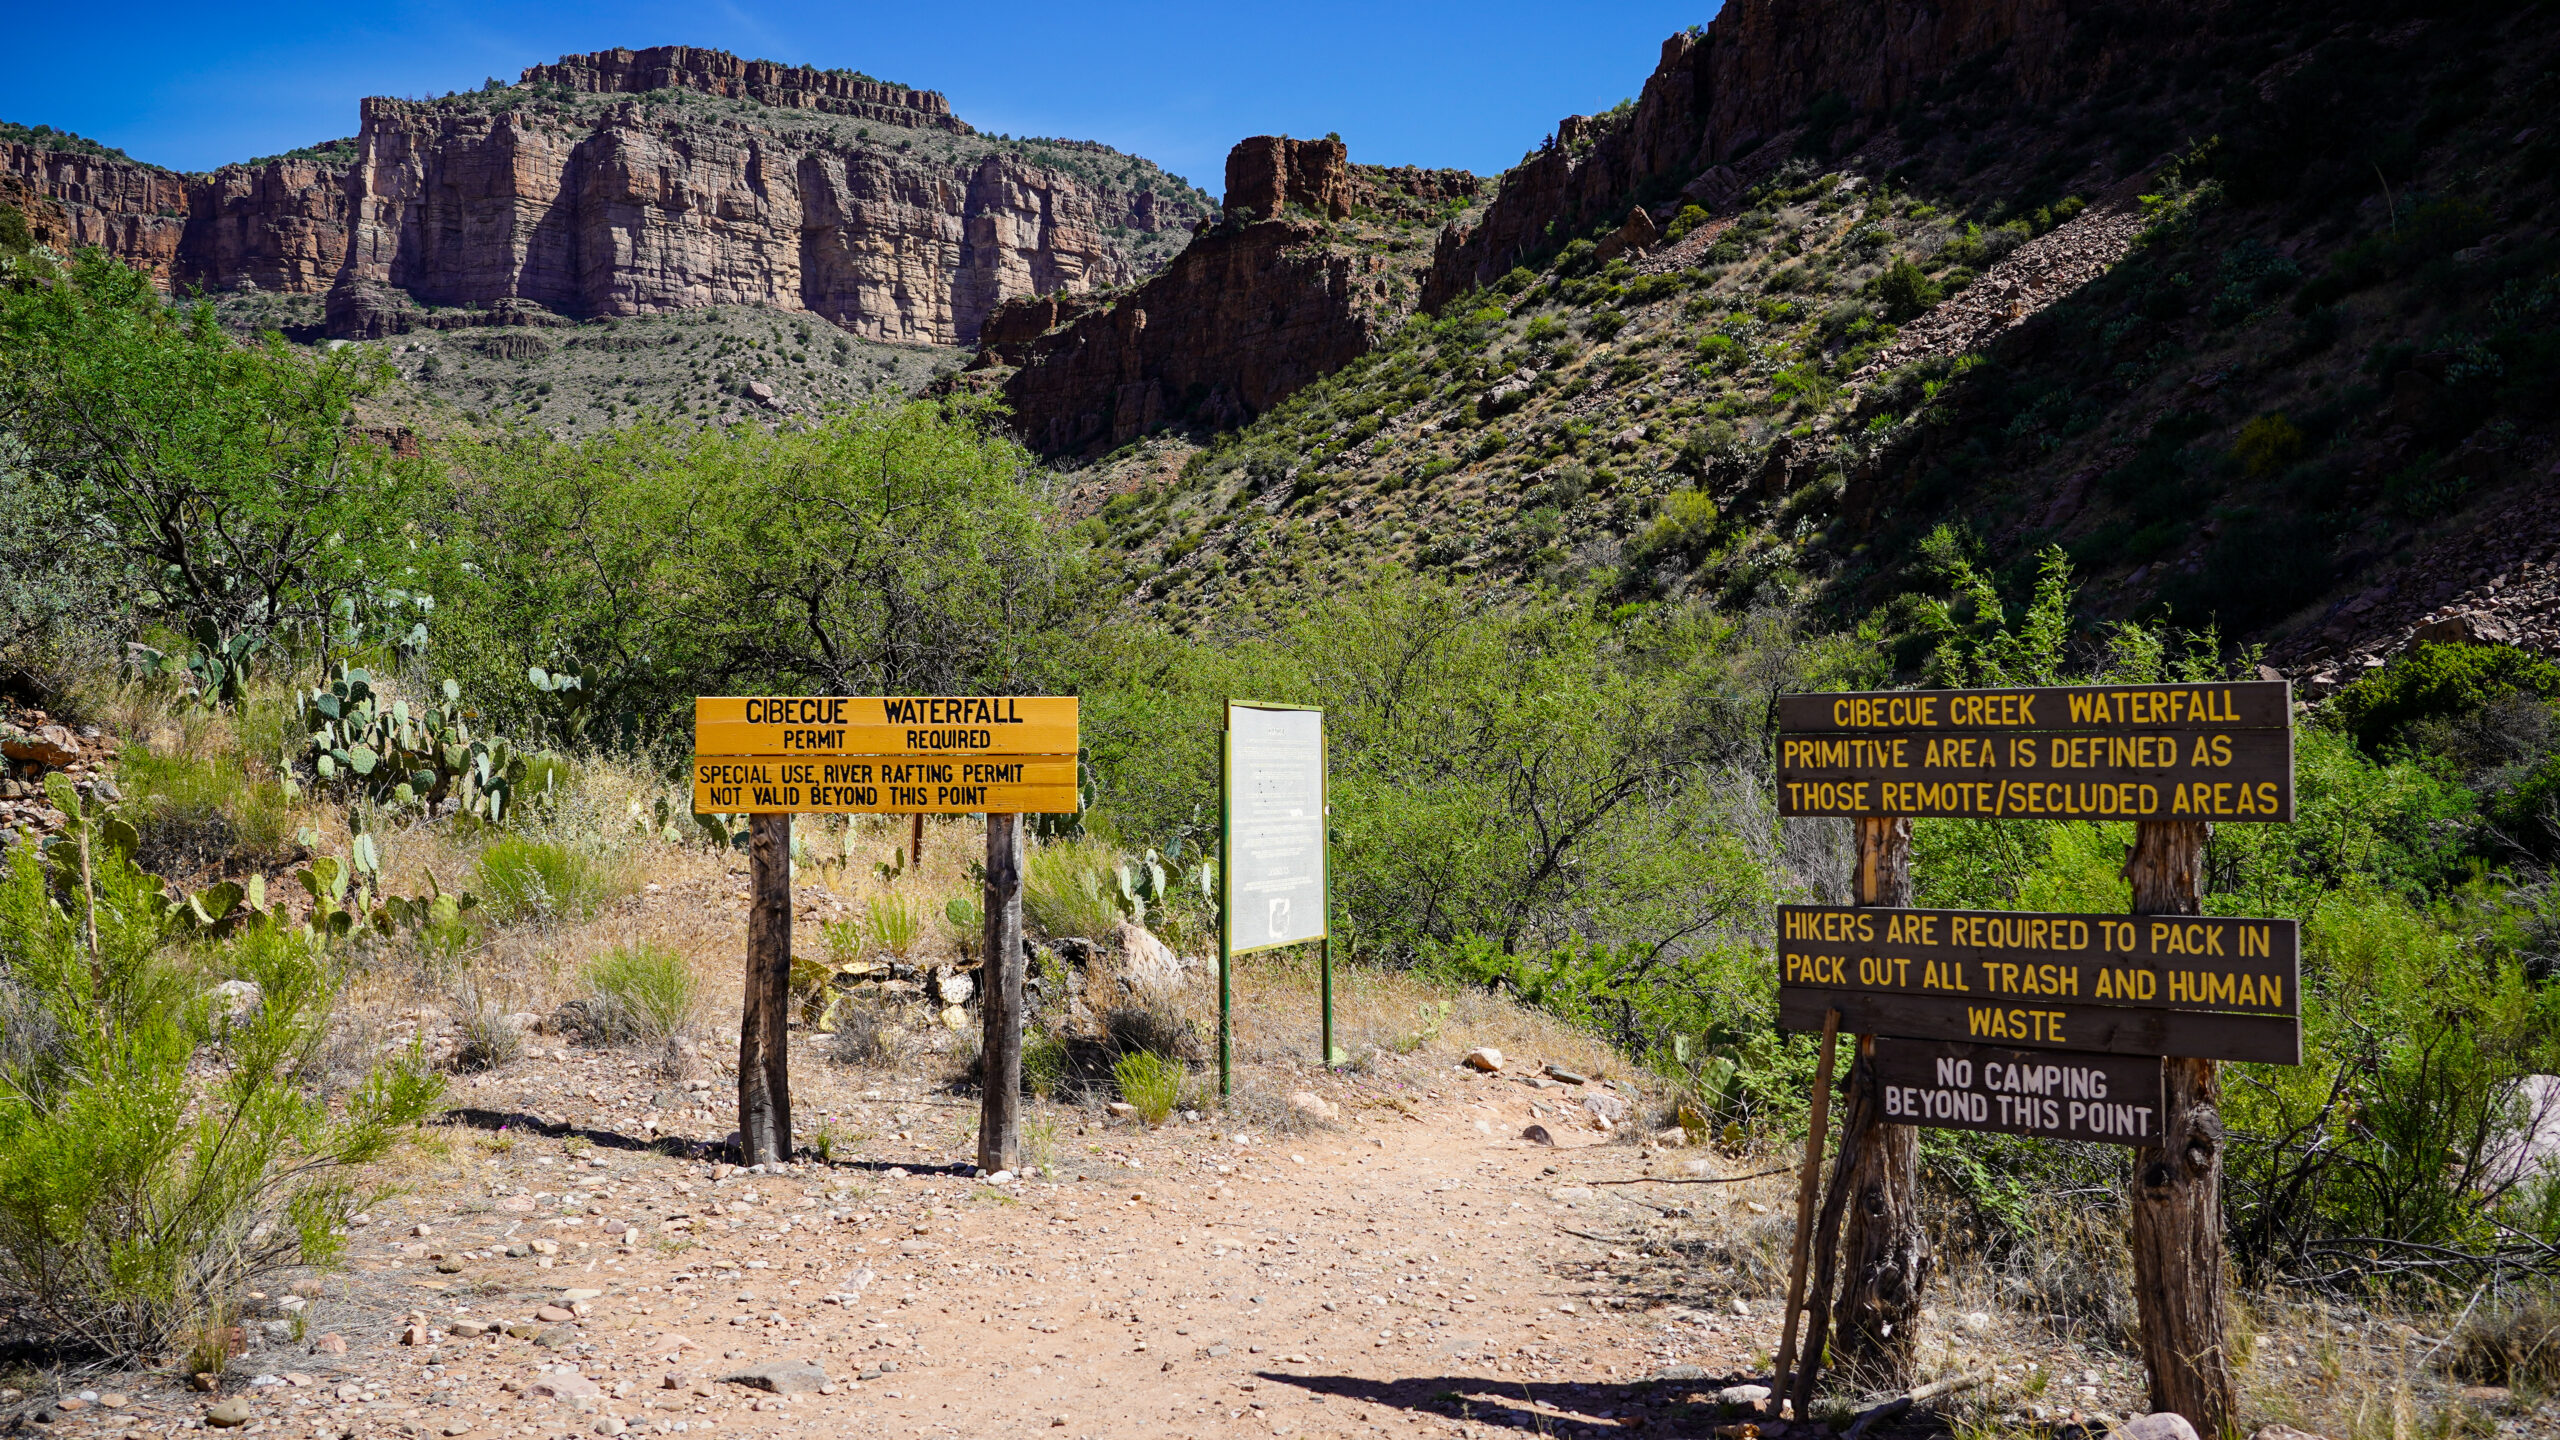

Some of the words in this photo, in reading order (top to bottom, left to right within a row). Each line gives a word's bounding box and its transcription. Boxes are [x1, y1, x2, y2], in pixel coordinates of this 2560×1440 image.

[746, 699, 848, 724] CIBECUE
[884, 699, 1023, 724] WATERFALL
[1834, 697, 1937, 726] CIBECUE
[1951, 695, 2035, 725] CREEK
[2069, 690, 2240, 723] WATERFALL
[784, 730, 845, 749] PERMIT
[907, 730, 990, 749] REQUIRED
[1785, 739, 1908, 768] PRIMITIVE
[1925, 739, 1995, 767] AREA
[2011, 739, 2036, 767] IS
[2052, 737, 2176, 767] DEFINED
[2192, 735, 2231, 766] AS
[700, 766, 771, 784] SPECIAL
[782, 765, 820, 787] USE,
[825, 765, 872, 783] RIVER
[882, 765, 952, 783] RAFTING
[964, 764, 1023, 782] PERMIT
[711, 787, 741, 805] NOT
[753, 787, 799, 805] VALID
[811, 787, 877, 805] BEYOND
[889, 787, 927, 805] THIS
[938, 787, 987, 805] POINT
[1787, 782, 1869, 810] THOSE
[1882, 780, 2157, 816] REMOTE/SECLUDED
[2173, 783, 2277, 813] AREAS
[1786, 912, 1873, 941] HIKERS
[1887, 915, 1938, 945] ARE
[1952, 917, 2088, 950] REQUIRED
[2099, 922, 2135, 951] TO
[2152, 923, 2224, 955] PACK
[2240, 926, 2269, 957] IN
[1787, 954, 1846, 984] PACK
[1860, 958, 1910, 986] OUT
[1924, 960, 1968, 991] ALL
[1983, 962, 2077, 995] TRASH
[2096, 968, 2155, 999] AND
[2169, 971, 2281, 1006] HUMAN
[1968, 1007, 2065, 1042] WASTE
[1938, 1058, 1971, 1087] NO
[1985, 1063, 2106, 1098] CAMPING
[1886, 1086, 1987, 1122] BEYOND
[1997, 1096, 2058, 1128] THIS
[2070, 1102, 2151, 1136] POINT
